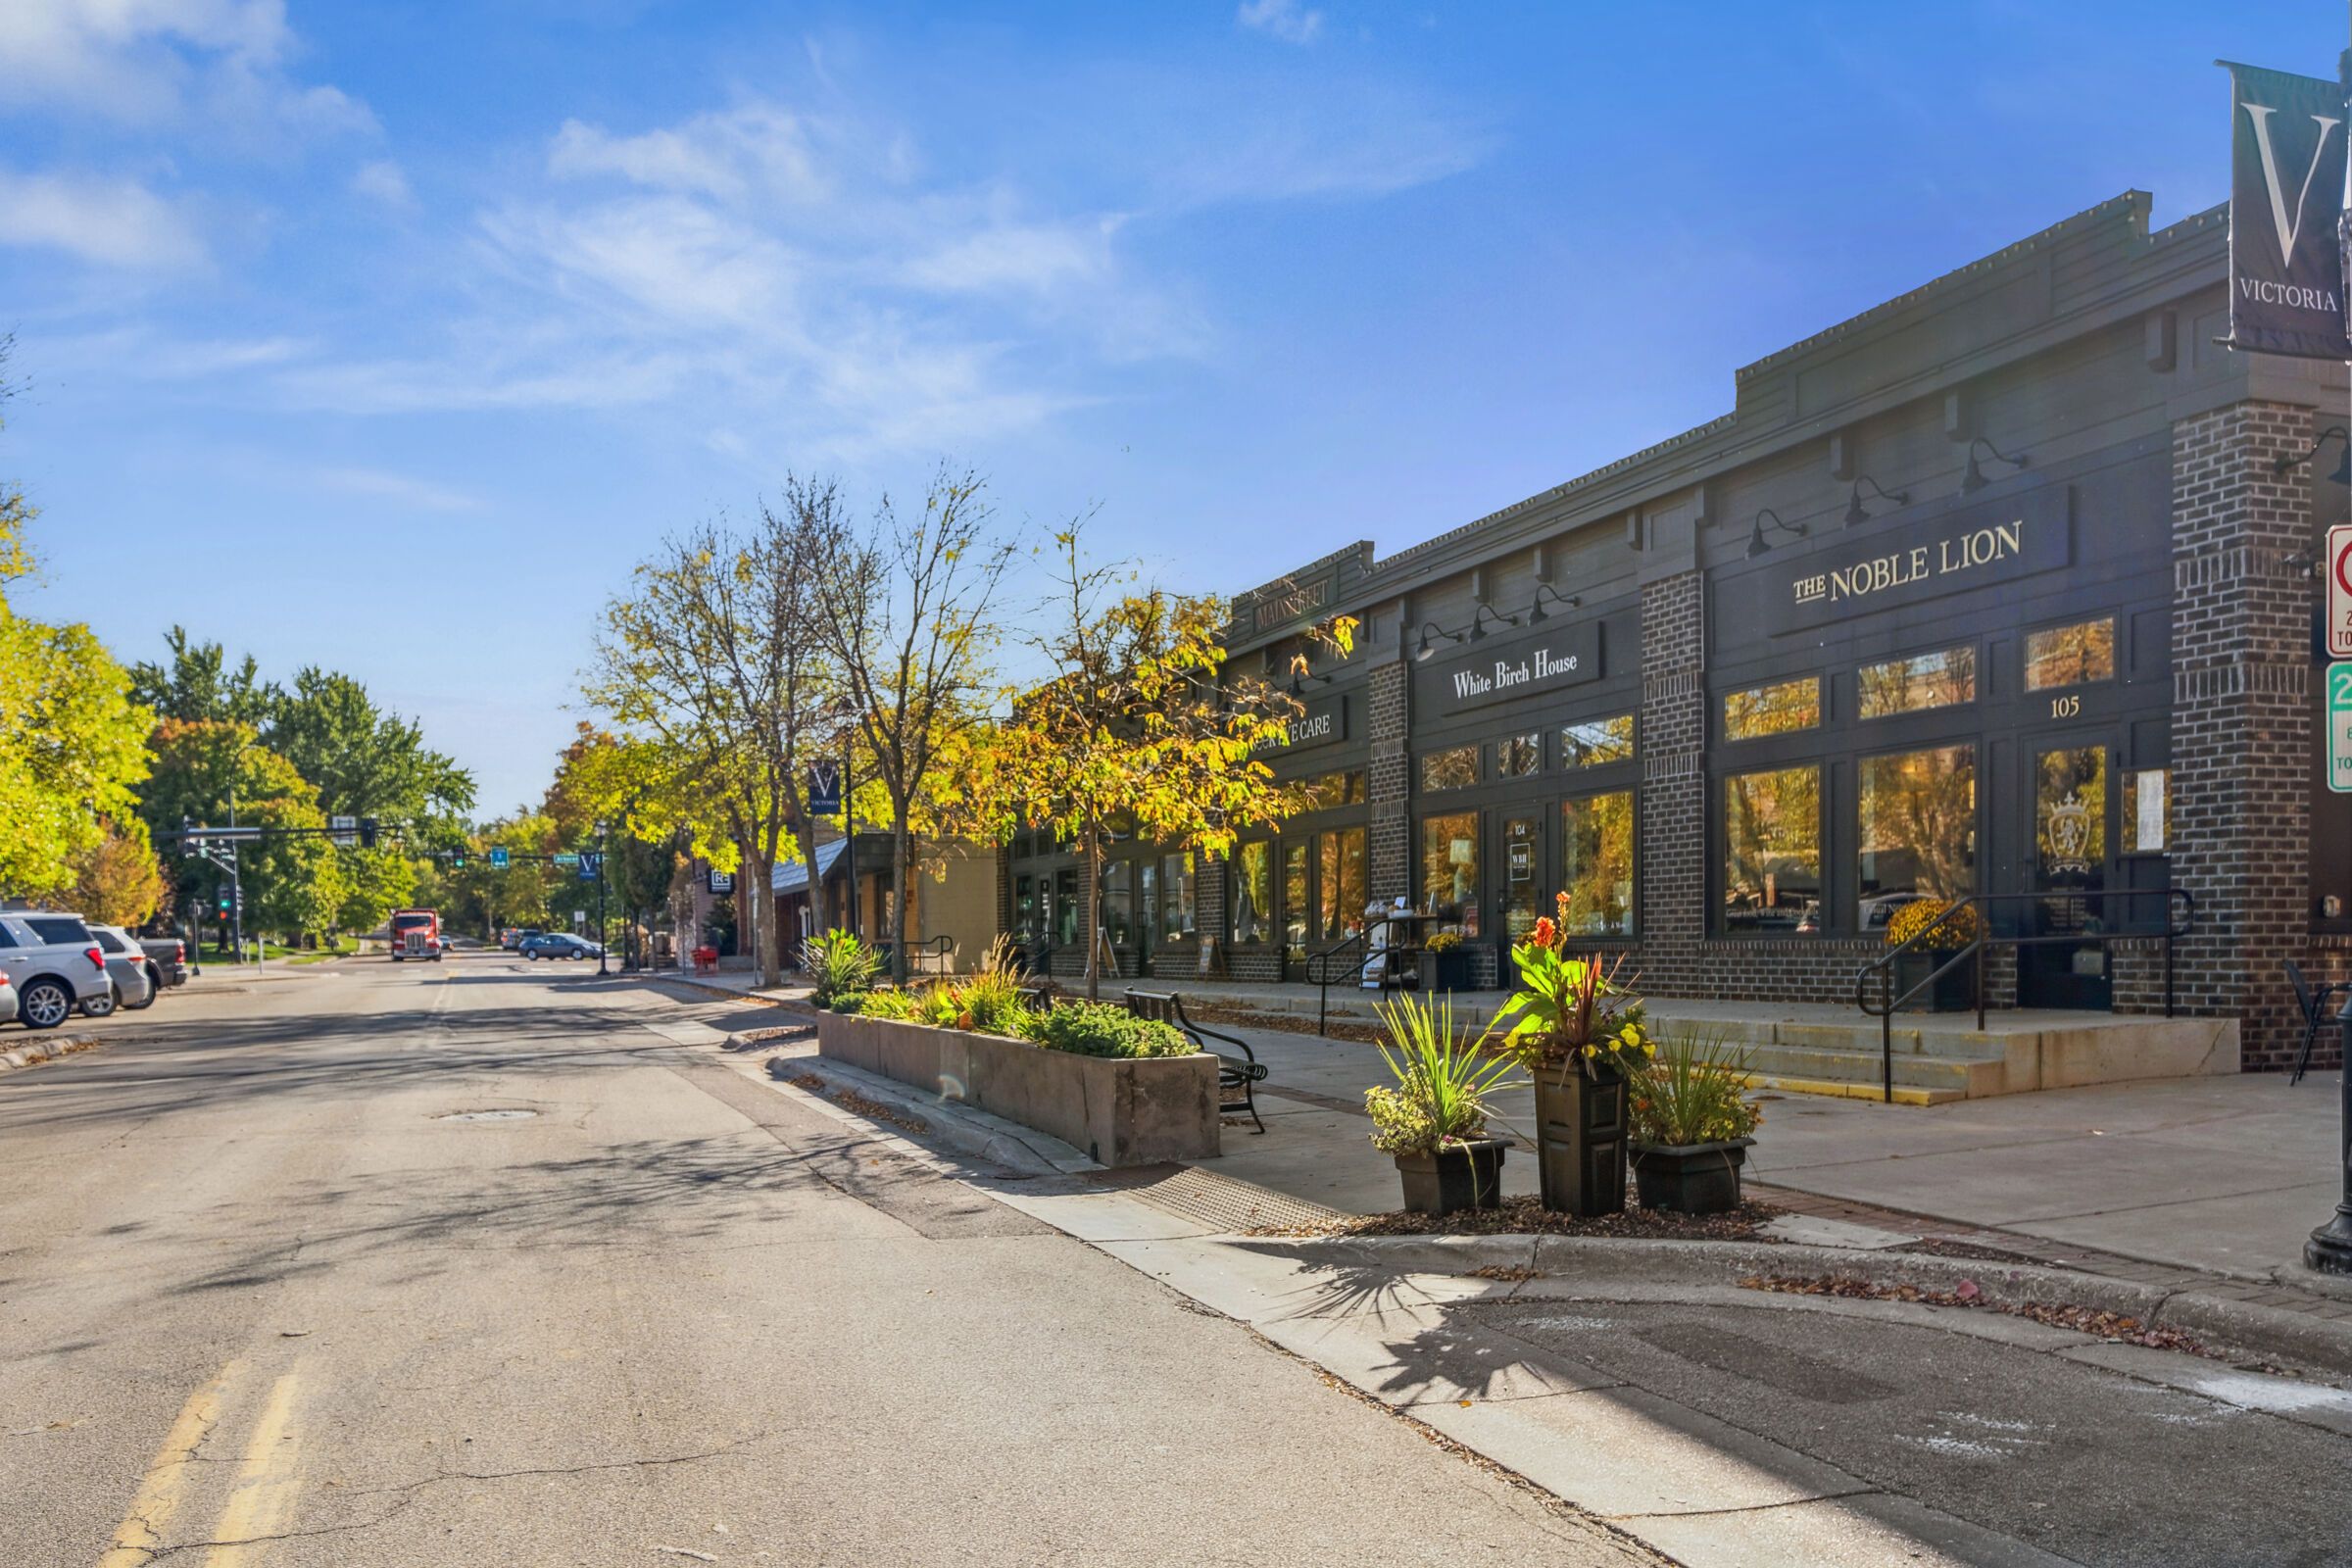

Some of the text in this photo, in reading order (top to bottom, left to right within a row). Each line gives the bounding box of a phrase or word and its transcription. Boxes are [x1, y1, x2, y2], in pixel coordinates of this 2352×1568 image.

[2240, 102, 2341, 269] V
[2240, 277, 2338, 312] VICTORIA
[1793, 520, 2023, 602] THE NOBLE LION
[1453, 649, 1578, 699] White Birch House
[2051, 696, 2080, 718] 105
[1299, 714, 1330, 740] CARE
[1514, 825, 1526, 836] 104
[580, 855, 595, 871] V
